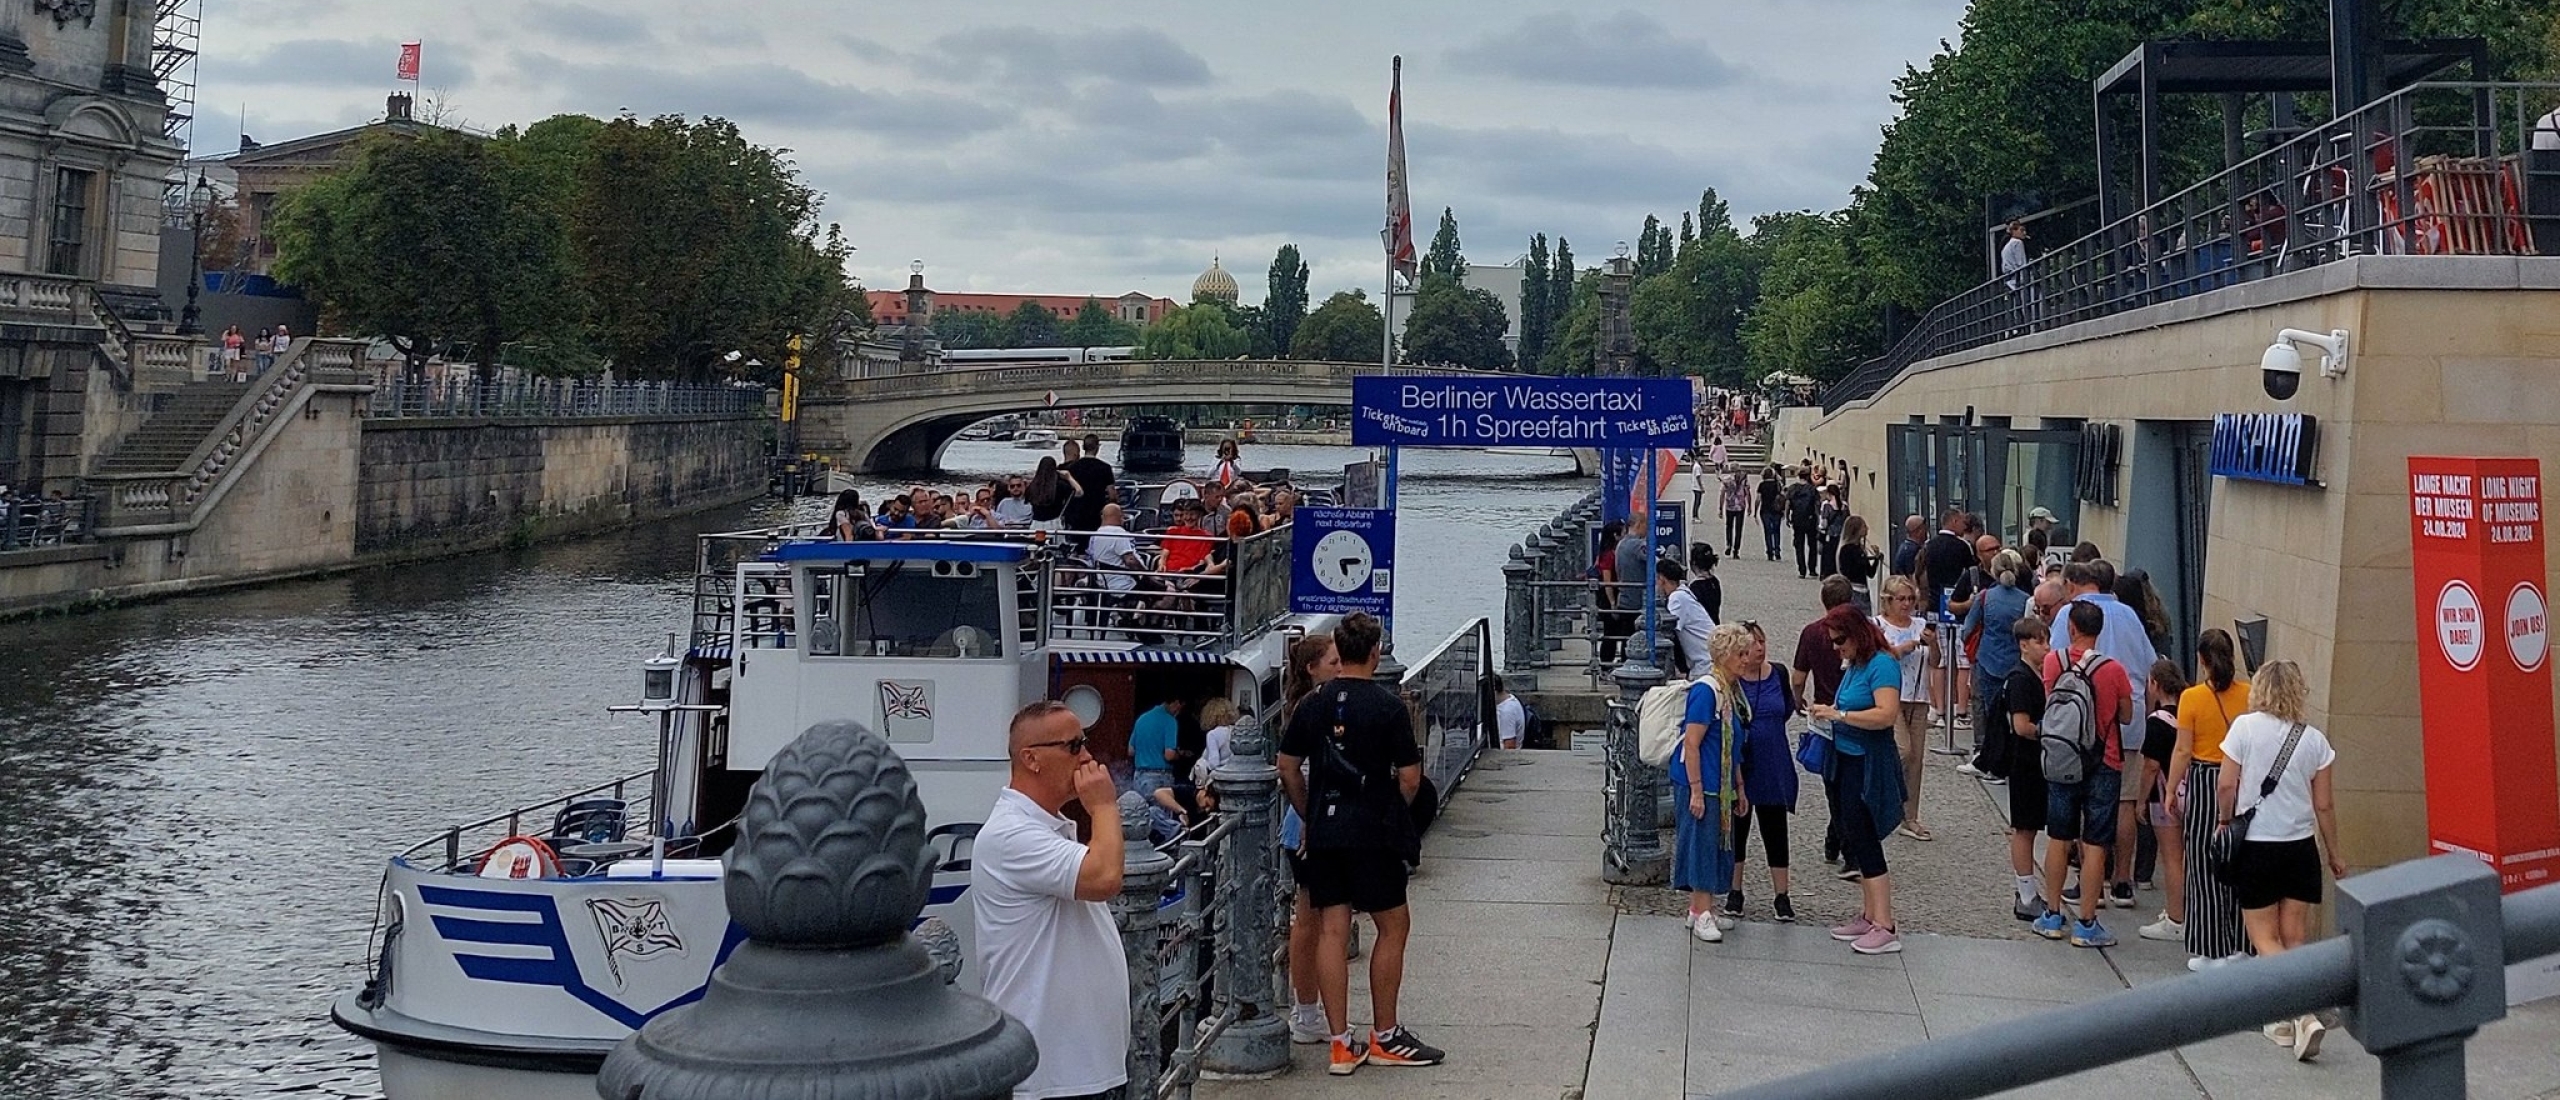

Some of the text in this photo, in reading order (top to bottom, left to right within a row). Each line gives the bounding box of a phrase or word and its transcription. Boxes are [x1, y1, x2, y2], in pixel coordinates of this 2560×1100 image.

[1402, 385, 1642, 411] Berliner Wassertaxi
[1437, 412, 1607, 443] 1h Spreefahrt
[1662, 418, 1688, 434] Bord
[2413, 474, 2471, 496] LANGE NACHT
[2481, 476, 2537, 499] LONG NIGHT
[2415, 497, 2474, 519] DER MUSEEN
[2482, 502, 2540, 523] OF MUSEUMS
[1334, 520, 1372, 529] departure
[2423, 520, 2467, 539] 24.08.2024
[2491, 525, 2533, 543] 24.08.2024
[2442, 608, 2476, 623] WIR SIND
[2449, 629, 2474, 645] DABEI!
[2510, 614, 2545, 639] JOIN US!
